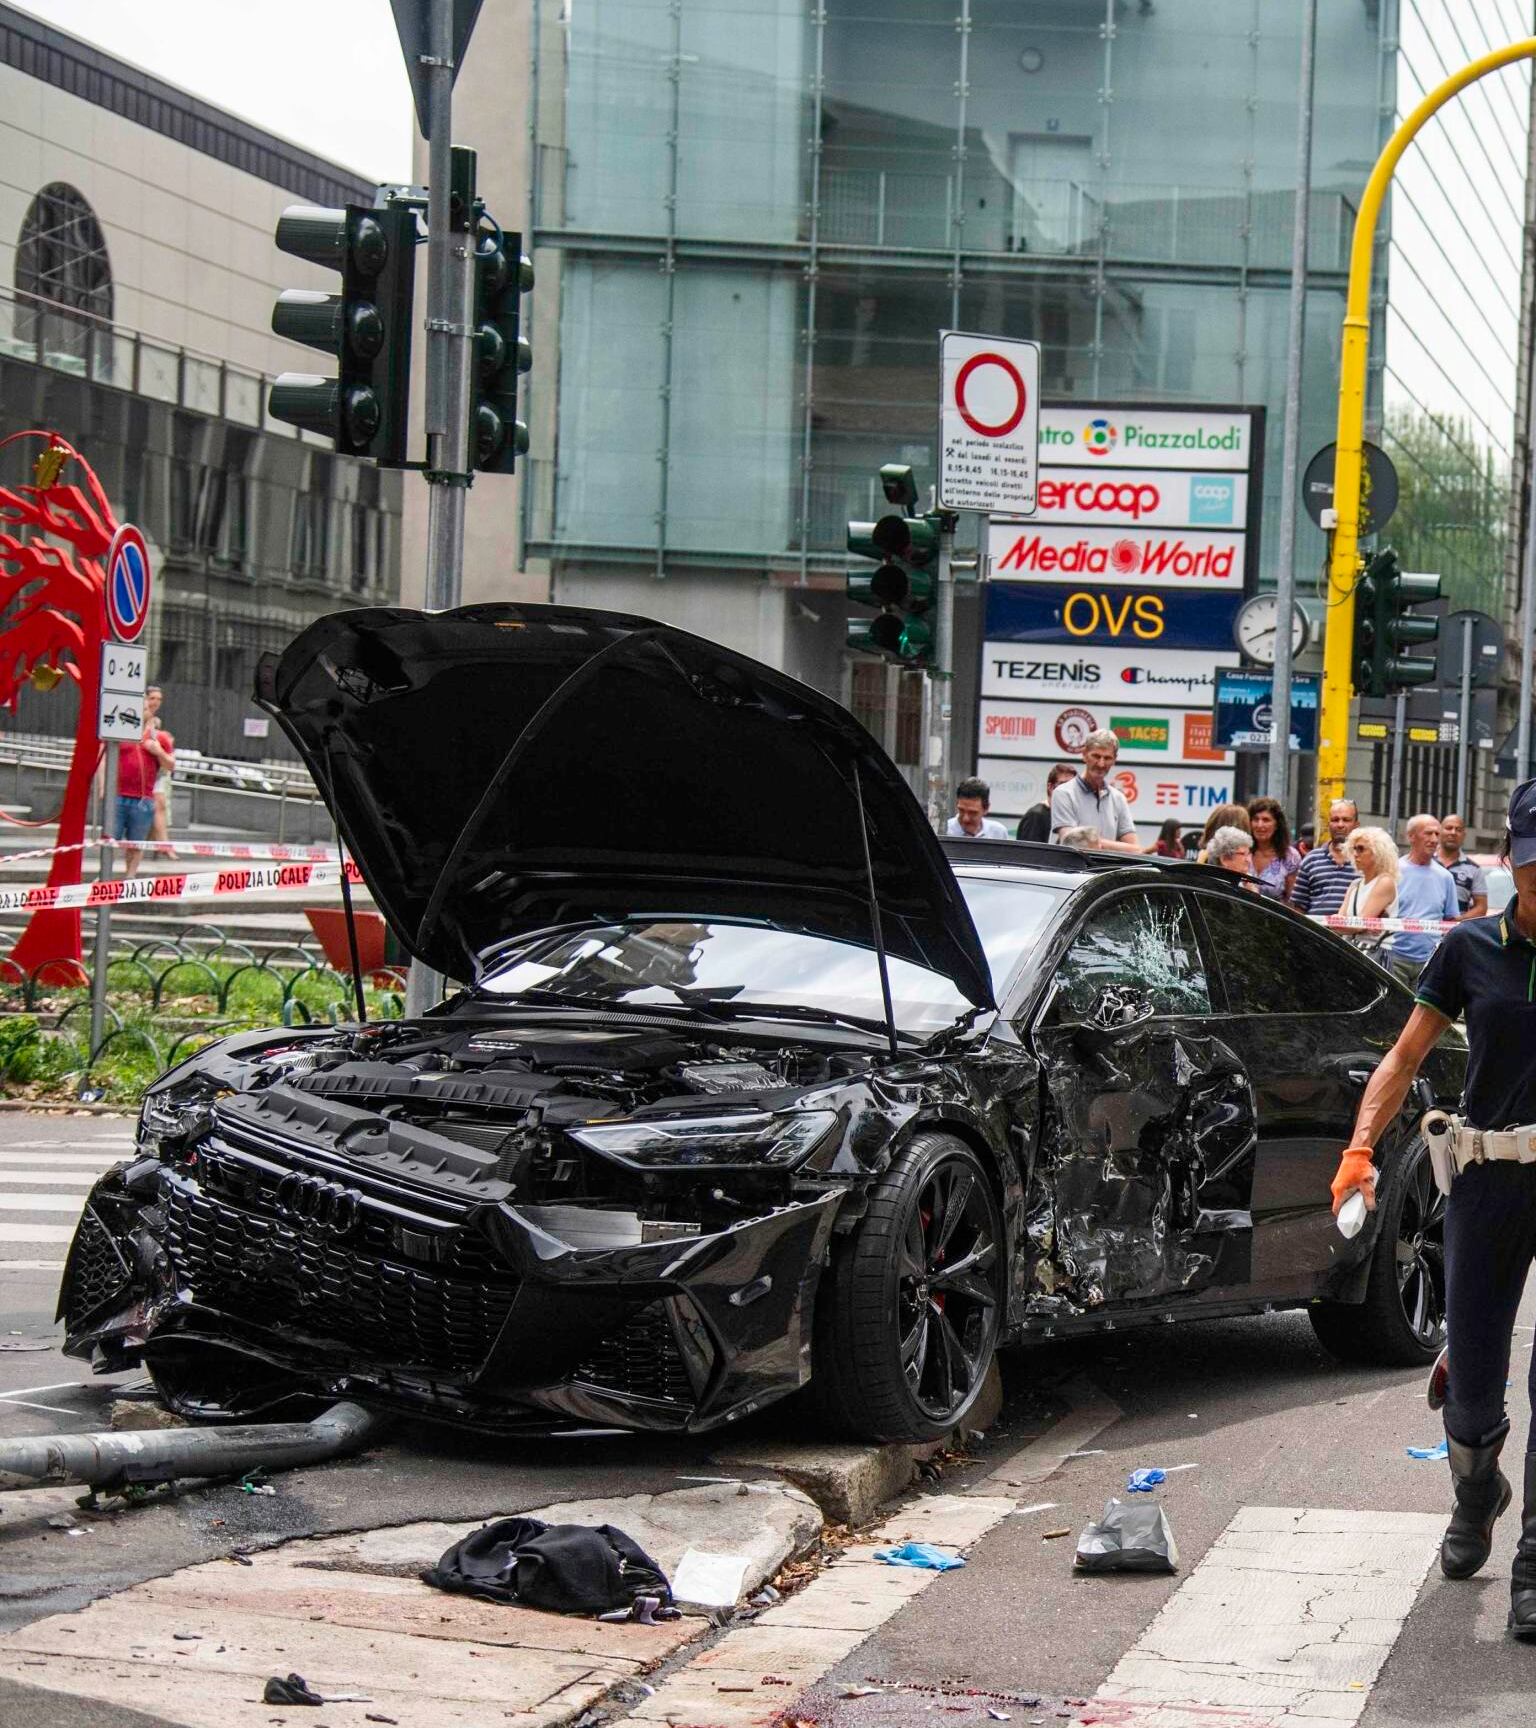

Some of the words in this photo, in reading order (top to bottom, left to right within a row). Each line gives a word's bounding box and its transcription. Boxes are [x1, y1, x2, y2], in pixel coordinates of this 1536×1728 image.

[966, 439, 989, 447] periodo
[992, 441, 1024, 450] scolastico
[1036, 480, 1161, 520] ercoop
[998, 535, 1108, 573] Media
[1140, 539, 1235, 578] World
[1063, 592, 1164, 639] OVS
[109, 659, 116, 676] 0
[128, 662, 141, 678] 24
[1184, 785, 1228, 807] TIM
[92, 880, 137, 902] POLIZIA
[140, 877, 183, 898] LOCALE
[218, 870, 263, 891] POLIZIA
[267, 866, 310, 887] LOCALE
[14, 890, 57, 909] LOCALE
